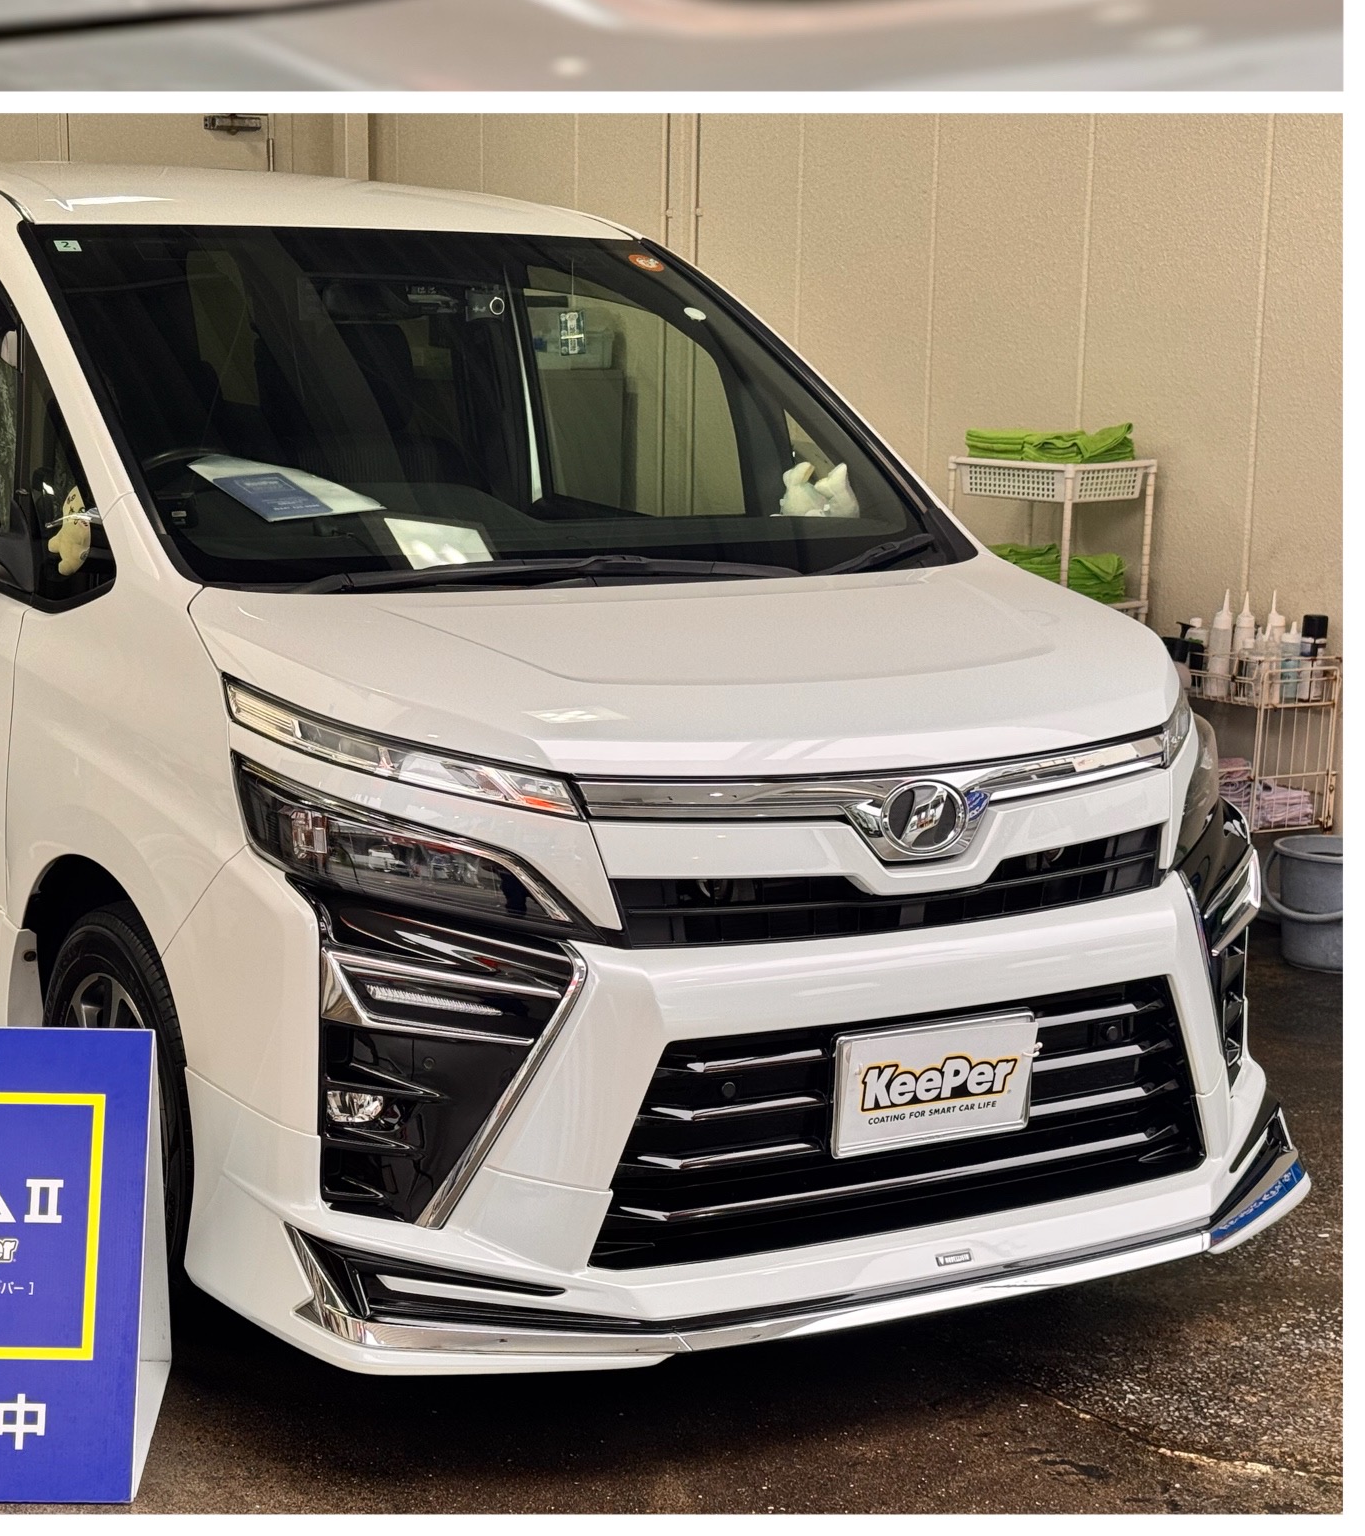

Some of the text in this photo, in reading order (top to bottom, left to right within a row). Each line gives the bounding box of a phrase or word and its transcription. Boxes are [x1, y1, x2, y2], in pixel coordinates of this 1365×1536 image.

[862, 1056, 1017, 1112] KeePer
[868, 1100, 997, 1125] COATING FOR SMART CAR LIFE
